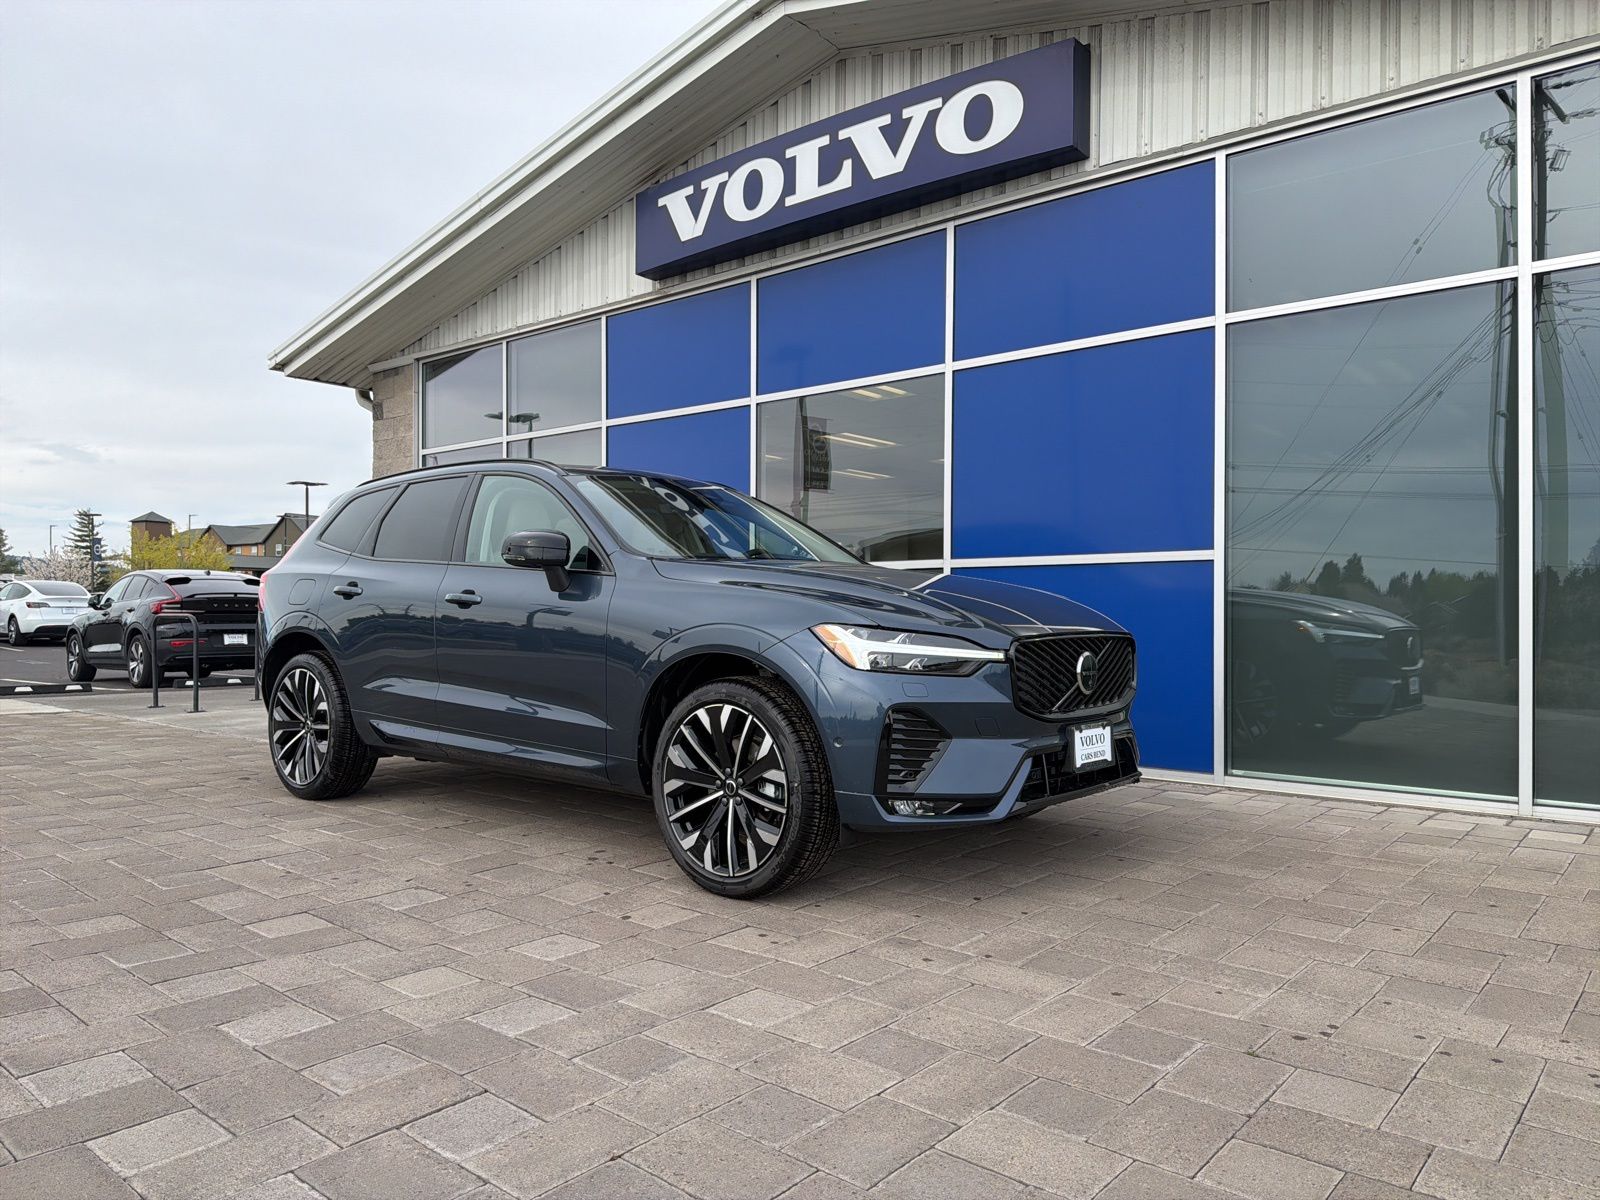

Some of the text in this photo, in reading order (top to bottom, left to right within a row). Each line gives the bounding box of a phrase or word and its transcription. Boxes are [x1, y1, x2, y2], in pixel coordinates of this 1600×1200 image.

[658, 80, 1024, 241] VOLVO
[1080, 733, 1105, 746] VOLVO
[1081, 750, 1106, 761] CARS BEND
